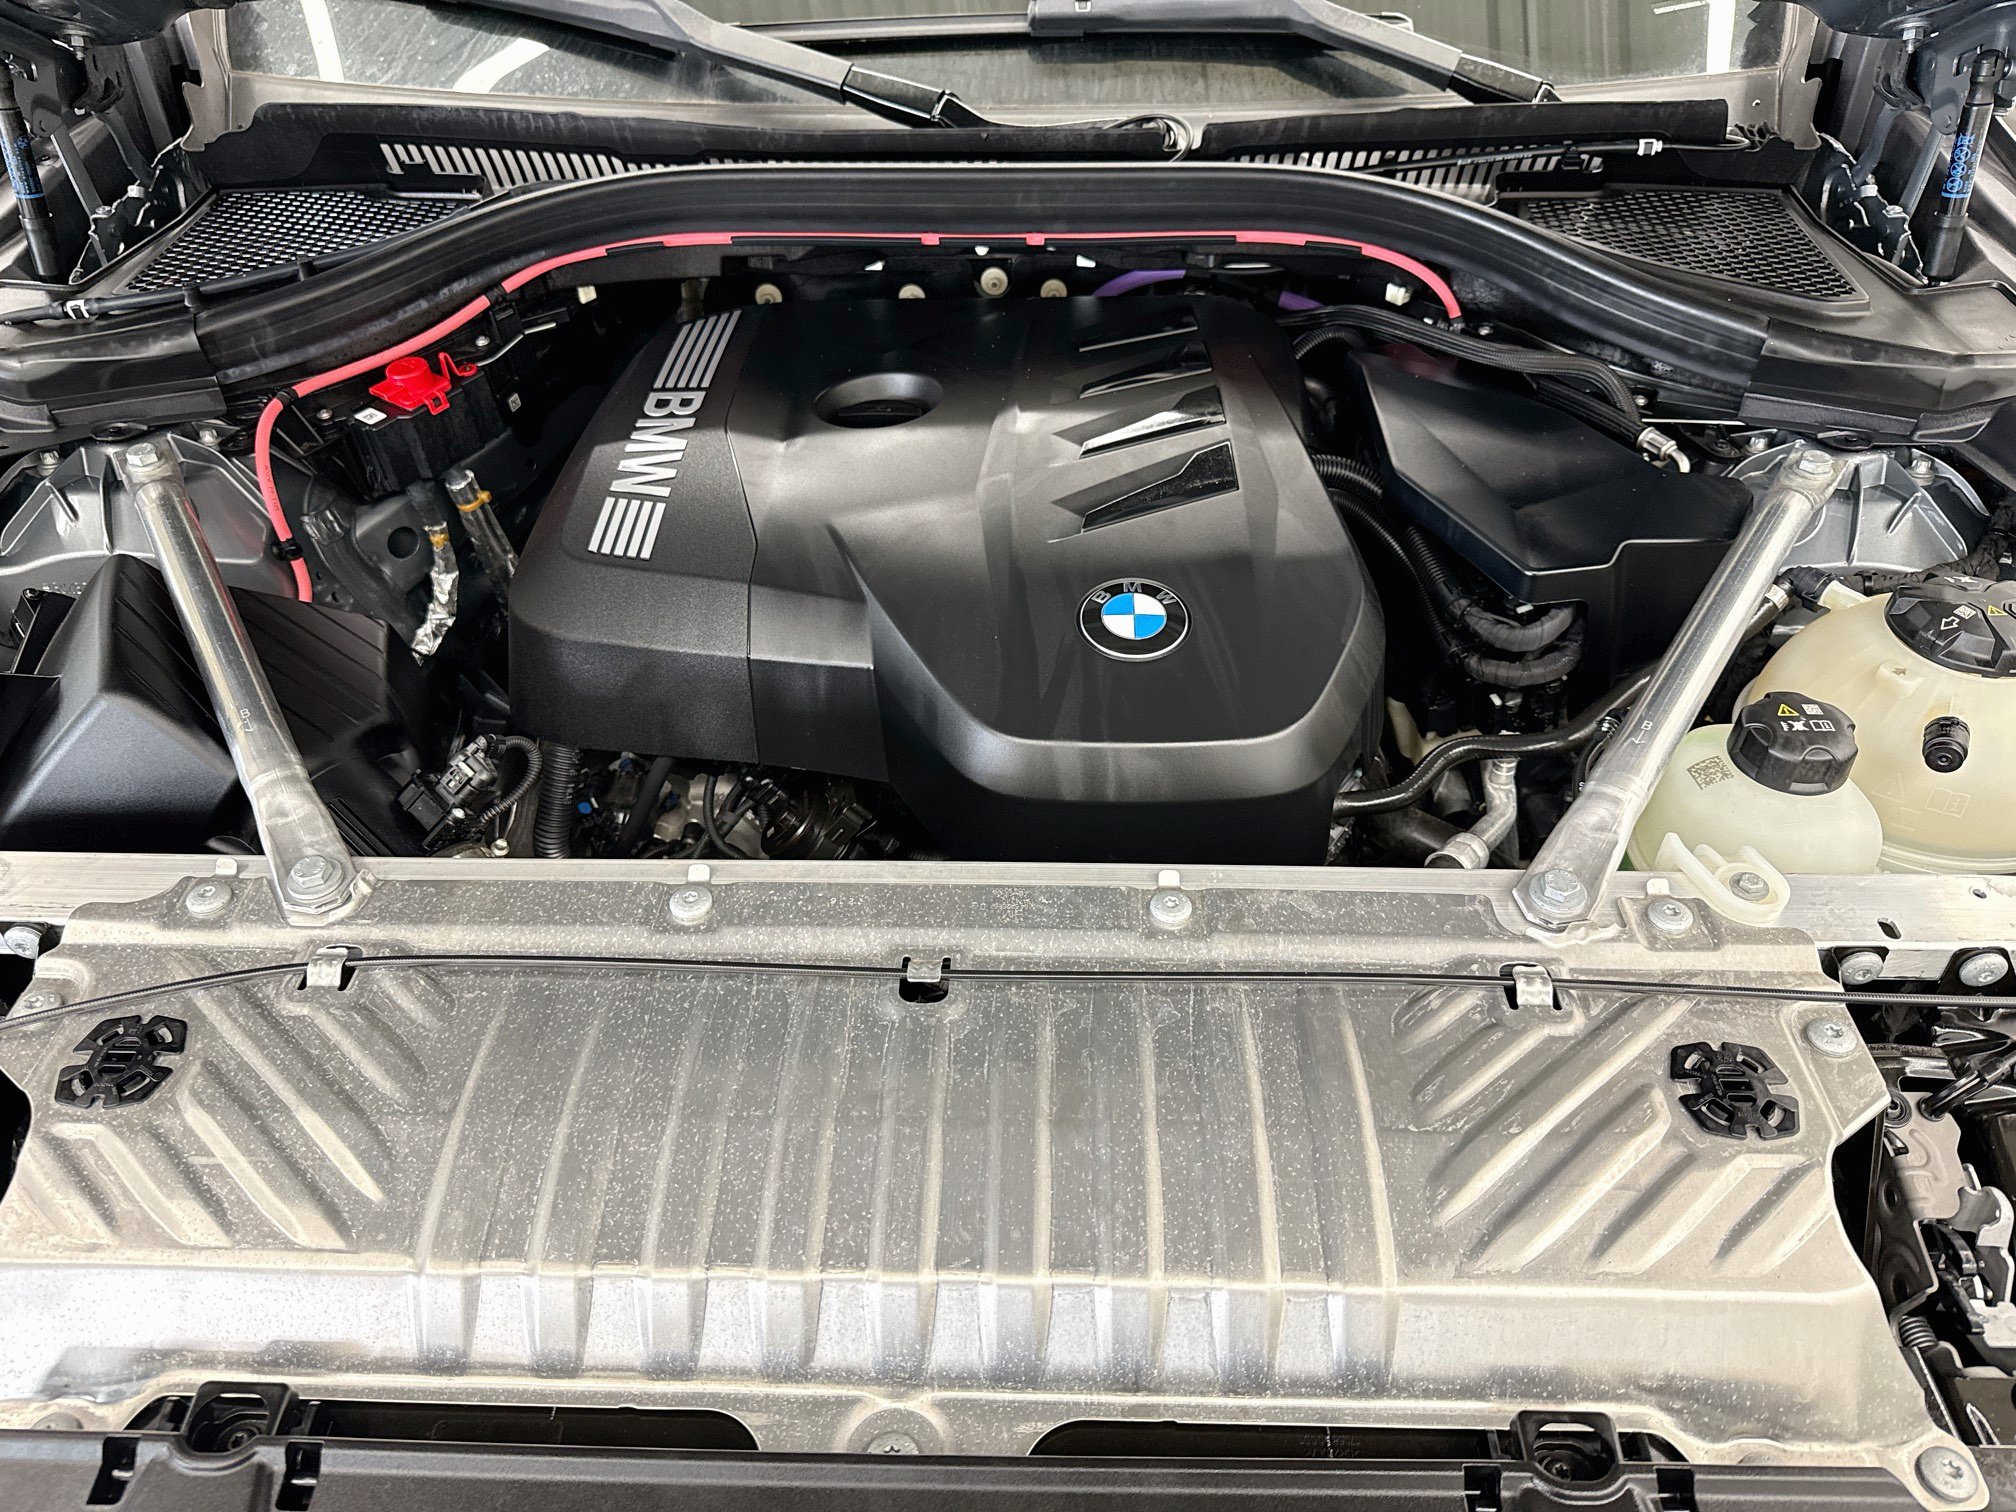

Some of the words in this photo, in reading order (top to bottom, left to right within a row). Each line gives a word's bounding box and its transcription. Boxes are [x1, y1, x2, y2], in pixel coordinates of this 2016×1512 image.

[609, 390, 707, 498] BMW
[1091, 582, 1177, 605] BMW
[1641, 720, 1653, 731] B
